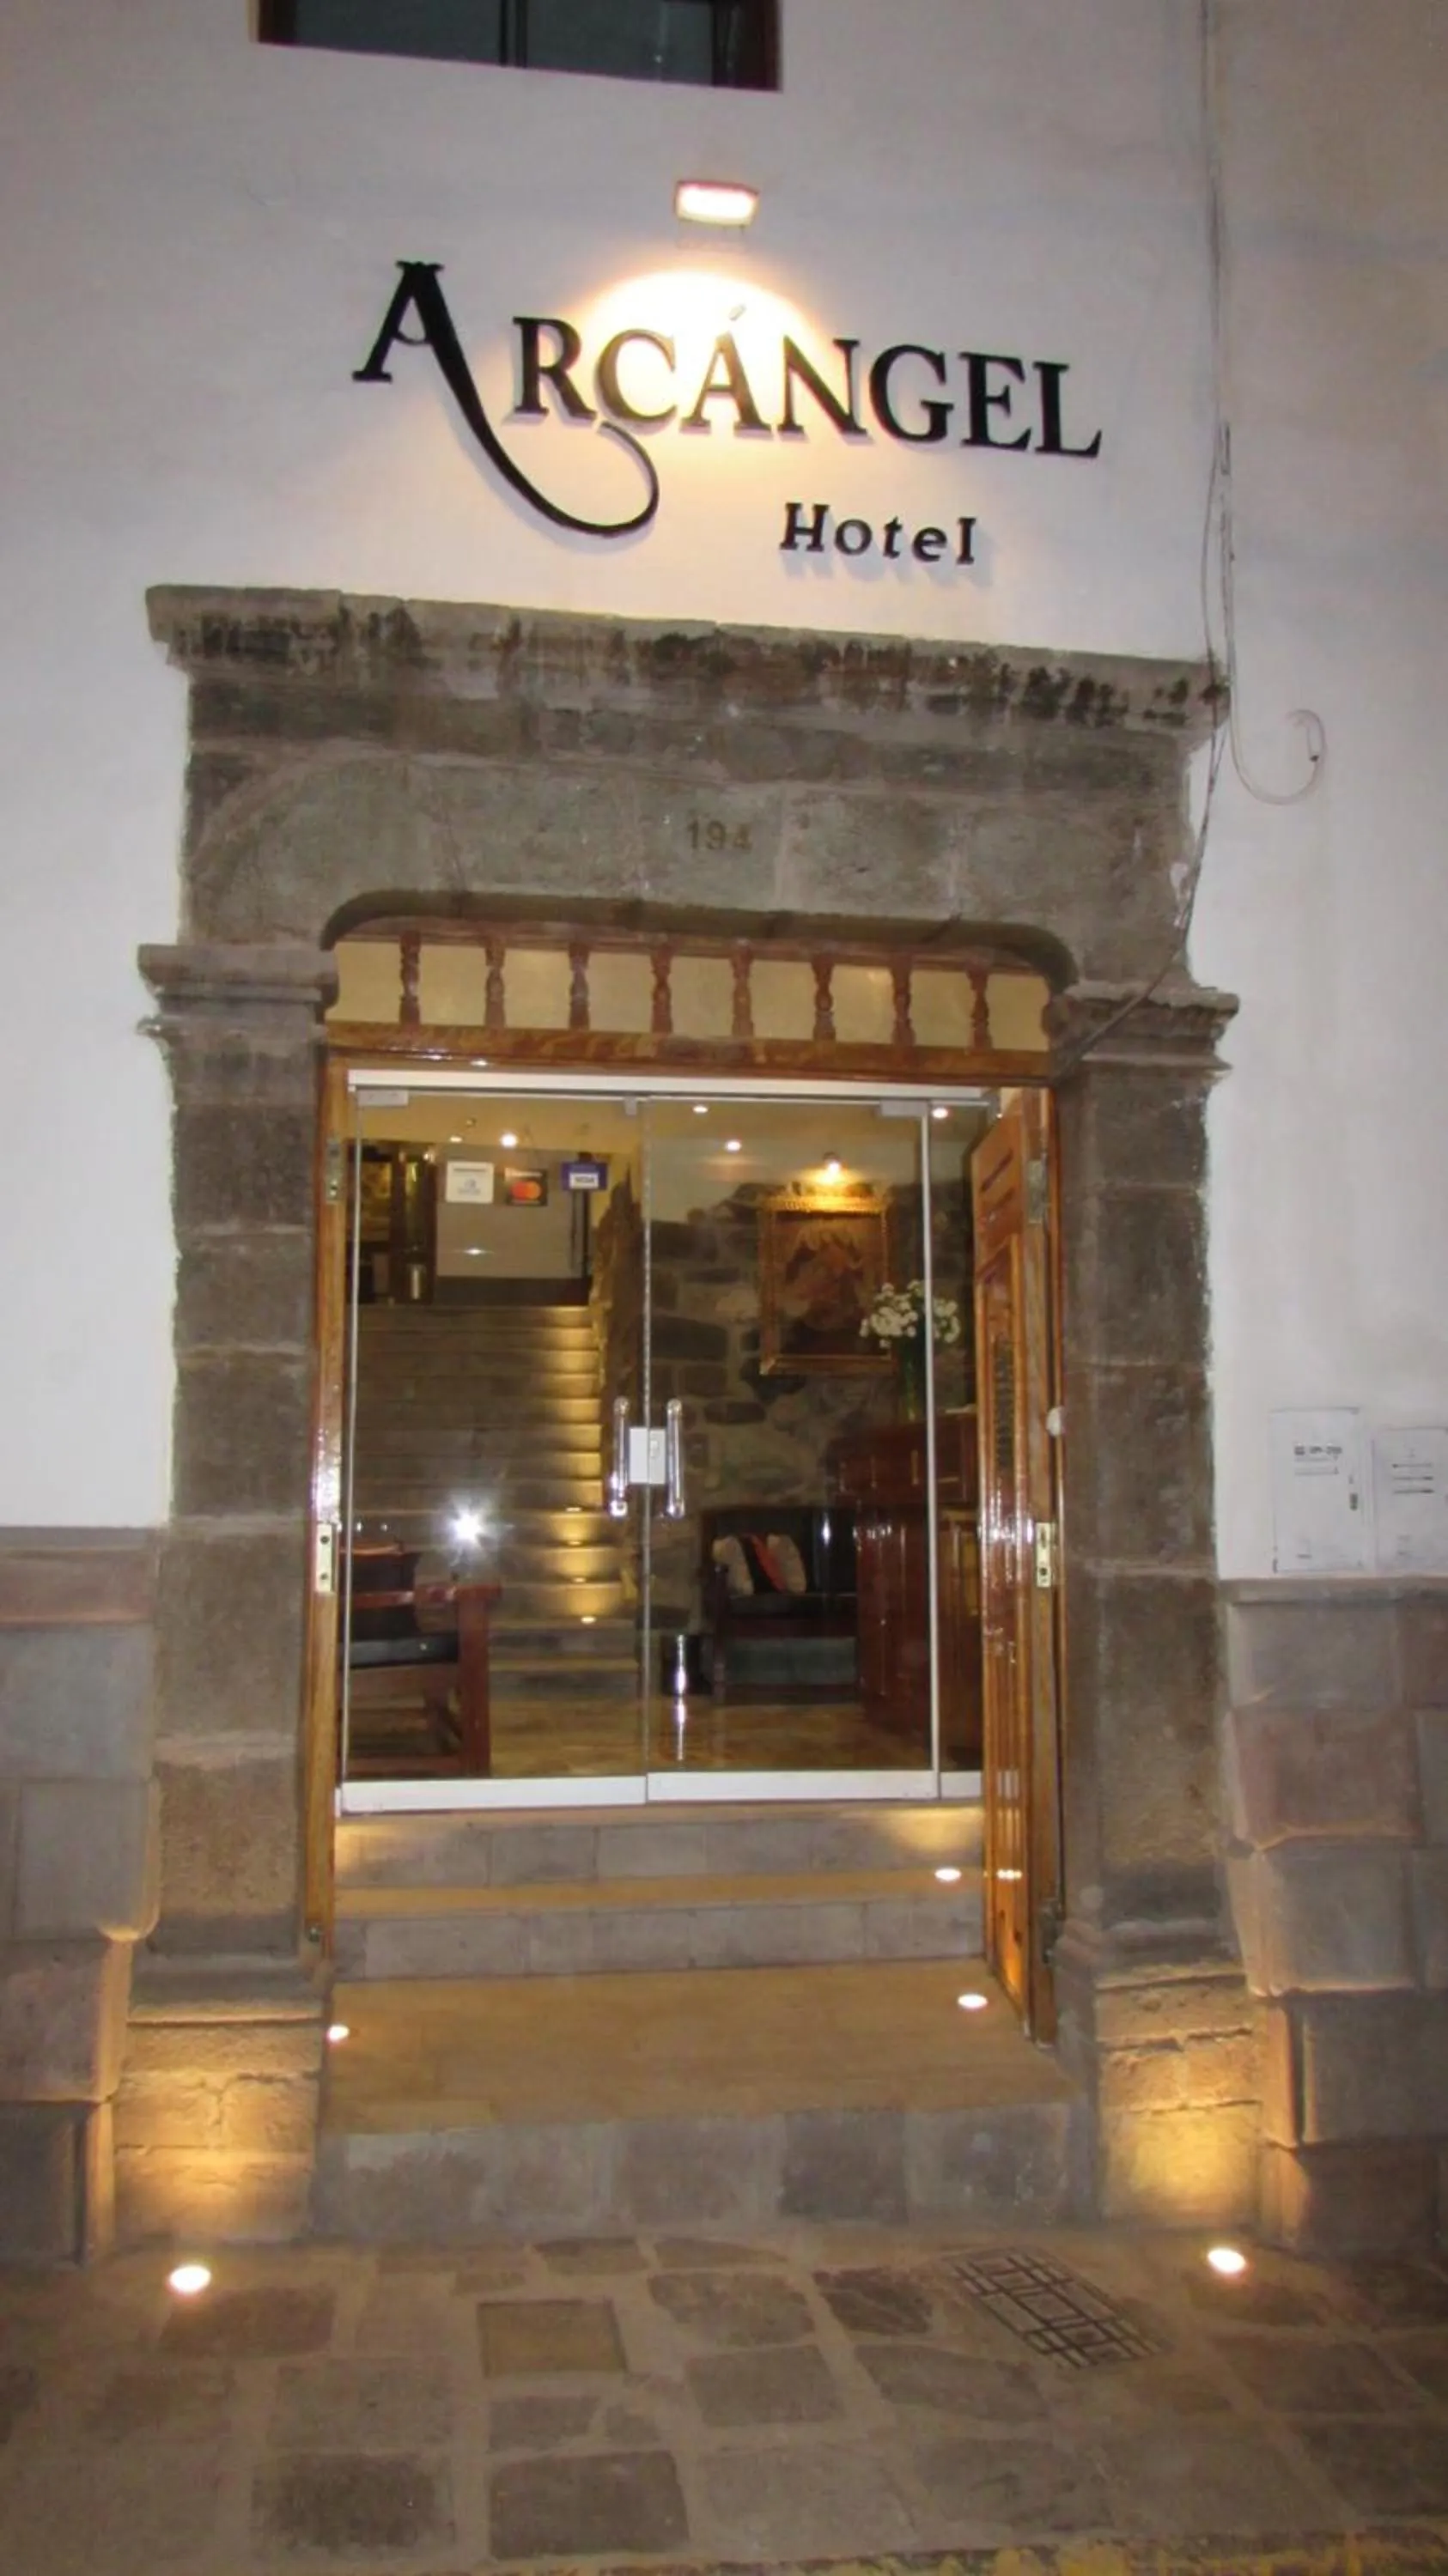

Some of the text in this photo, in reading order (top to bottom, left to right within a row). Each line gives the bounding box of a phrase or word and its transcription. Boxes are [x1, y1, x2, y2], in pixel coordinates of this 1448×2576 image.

[351, 260, 1101, 537] ARCÁNGEL
[780, 502, 976, 566] Hotel
[686, 820, 752, 852] 194
